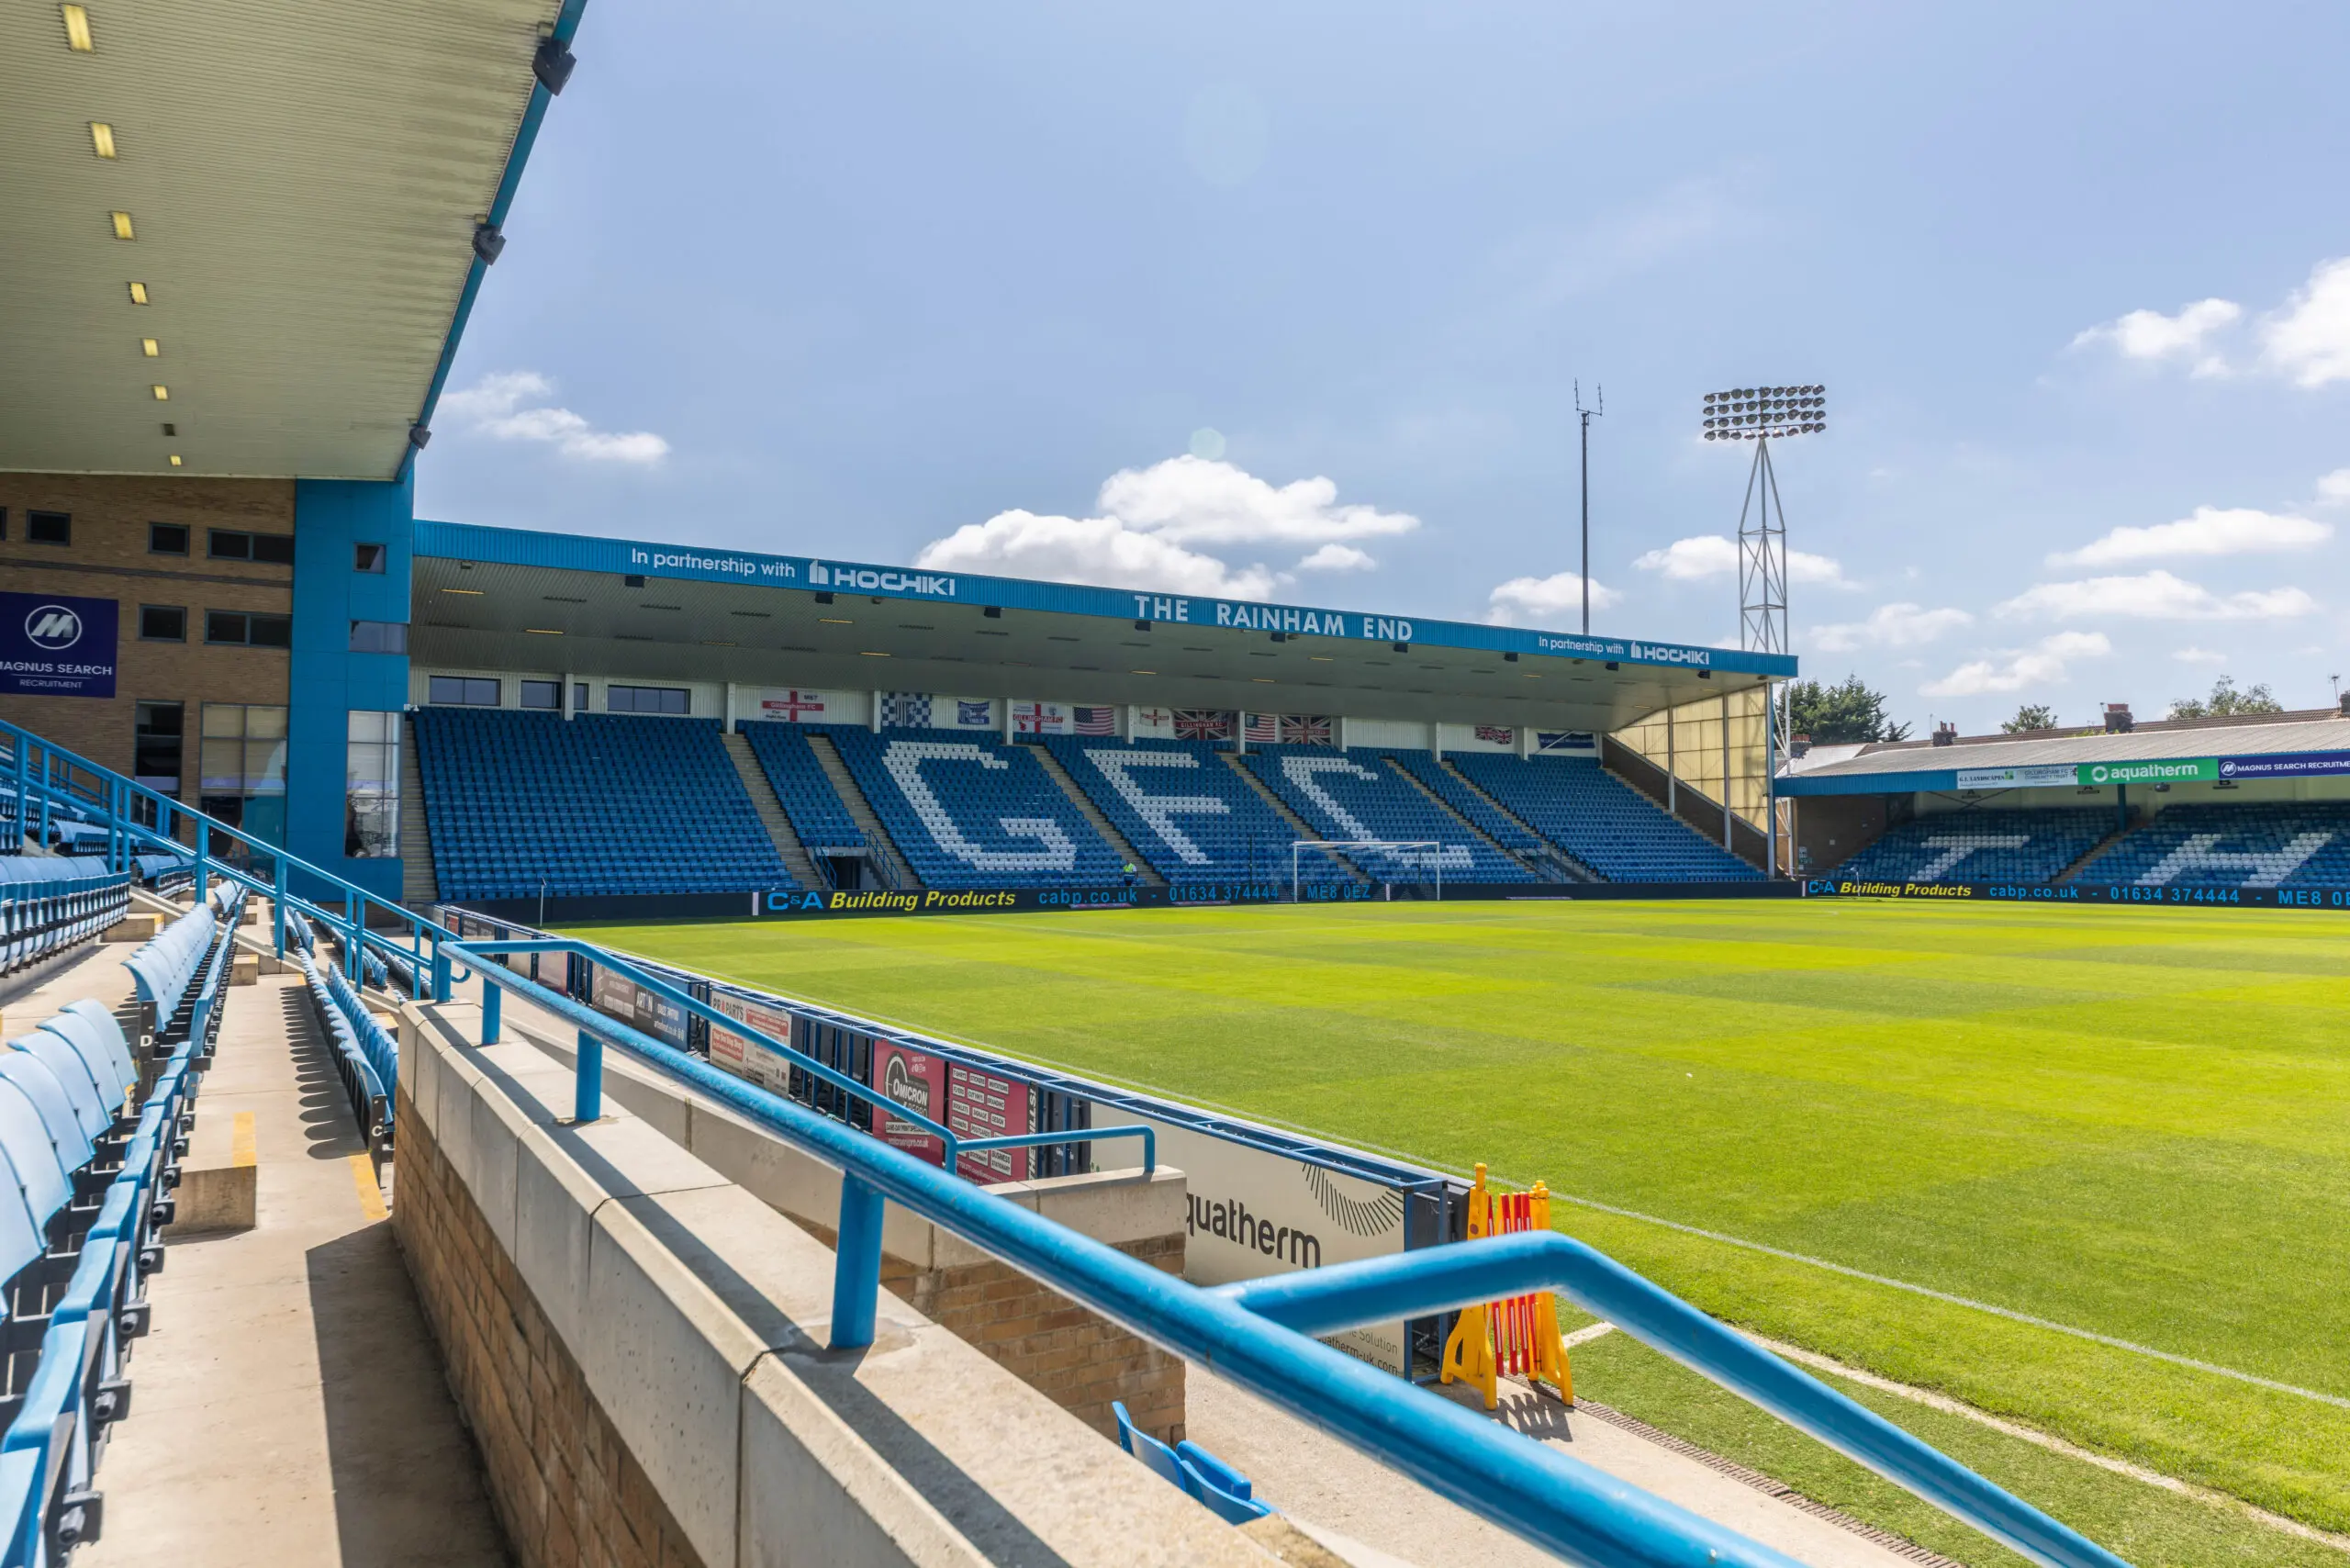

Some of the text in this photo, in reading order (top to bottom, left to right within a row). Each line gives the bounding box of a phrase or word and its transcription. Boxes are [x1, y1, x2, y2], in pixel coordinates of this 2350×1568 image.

[632, 548, 956, 596] In partnership with HOCHIKI
[1135, 595, 1412, 641] THE RAINHAM END
[1539, 636, 1709, 665] In partnership with HOCHIKI
[57, 664, 112, 675] SEARCH
[19, 679, 83, 689] RECRUITMENT
[2111, 764, 2198, 780] aquatherm
[2238, 764, 2272, 772] MAGNUS
[2274, 762, 2306, 770] SEARCH
[767, 891, 823, 910] C&A
[830, 891, 918, 911] Building
[925, 890, 1016, 907] Products
[1038, 887, 1137, 904] cabp.co.uk
[1169, 886, 1216, 902] 01634
[1224, 885, 1279, 900] 374444
[1307, 884, 1337, 900] ME8
[1344, 884, 1371, 899] 0EZ
[1808, 880, 1836, 893] C&A
[1840, 881, 1900, 898] Building
[1904, 883, 1972, 897] Products
[1989, 884, 2079, 900] cabp.co.uk
[2110, 887, 2163, 901] 01634
[2171, 888, 2240, 902] 374444
[2278, 890, 2322, 905] ME8
[140, 1035, 152, 1047] D
[893, 1078, 928, 1106] OMICRON
[372, 1125, 383, 1137] C
[1028, 1088, 1036, 1181] THE ILLS!
[1360, 1328, 1398, 1355] Solution
